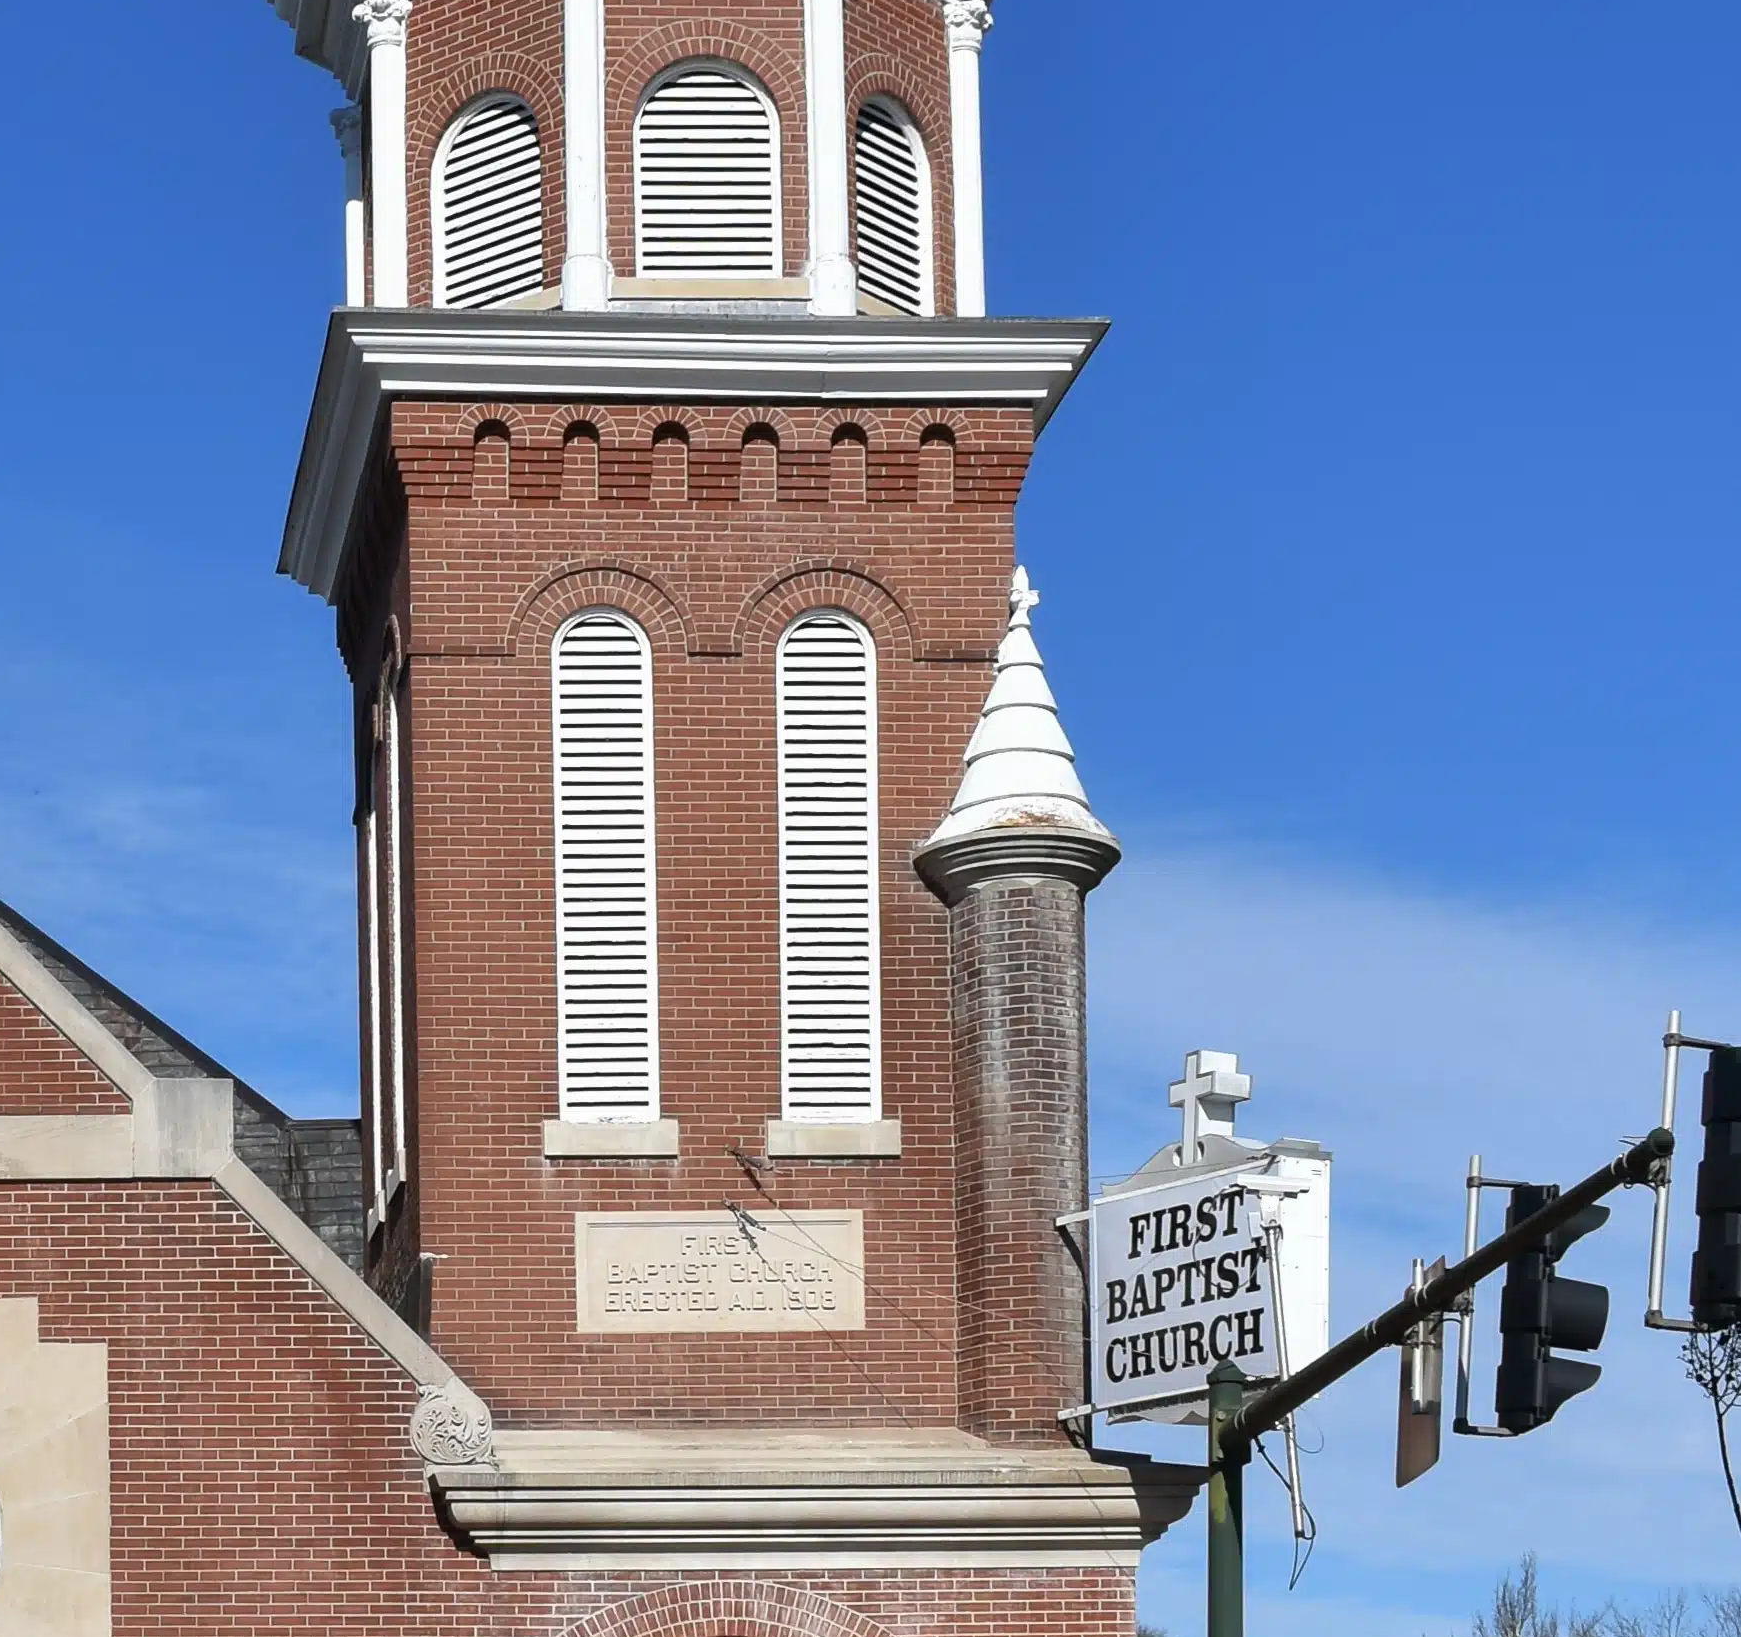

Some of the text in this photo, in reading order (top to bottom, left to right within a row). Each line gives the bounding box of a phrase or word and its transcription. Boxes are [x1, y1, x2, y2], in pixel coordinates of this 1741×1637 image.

[681, 1234, 757, 1255] FIRST
[1128, 1189, 1244, 1259] FIRST
[607, 1259, 833, 1283] BAPTIST CHURCH
[1106, 1245, 1268, 1324] BAPTIST
[605, 1290, 719, 1312] ERECTED
[728, 1289, 774, 1311] A.D.
[1106, 1307, 1265, 1383] CHURCH
